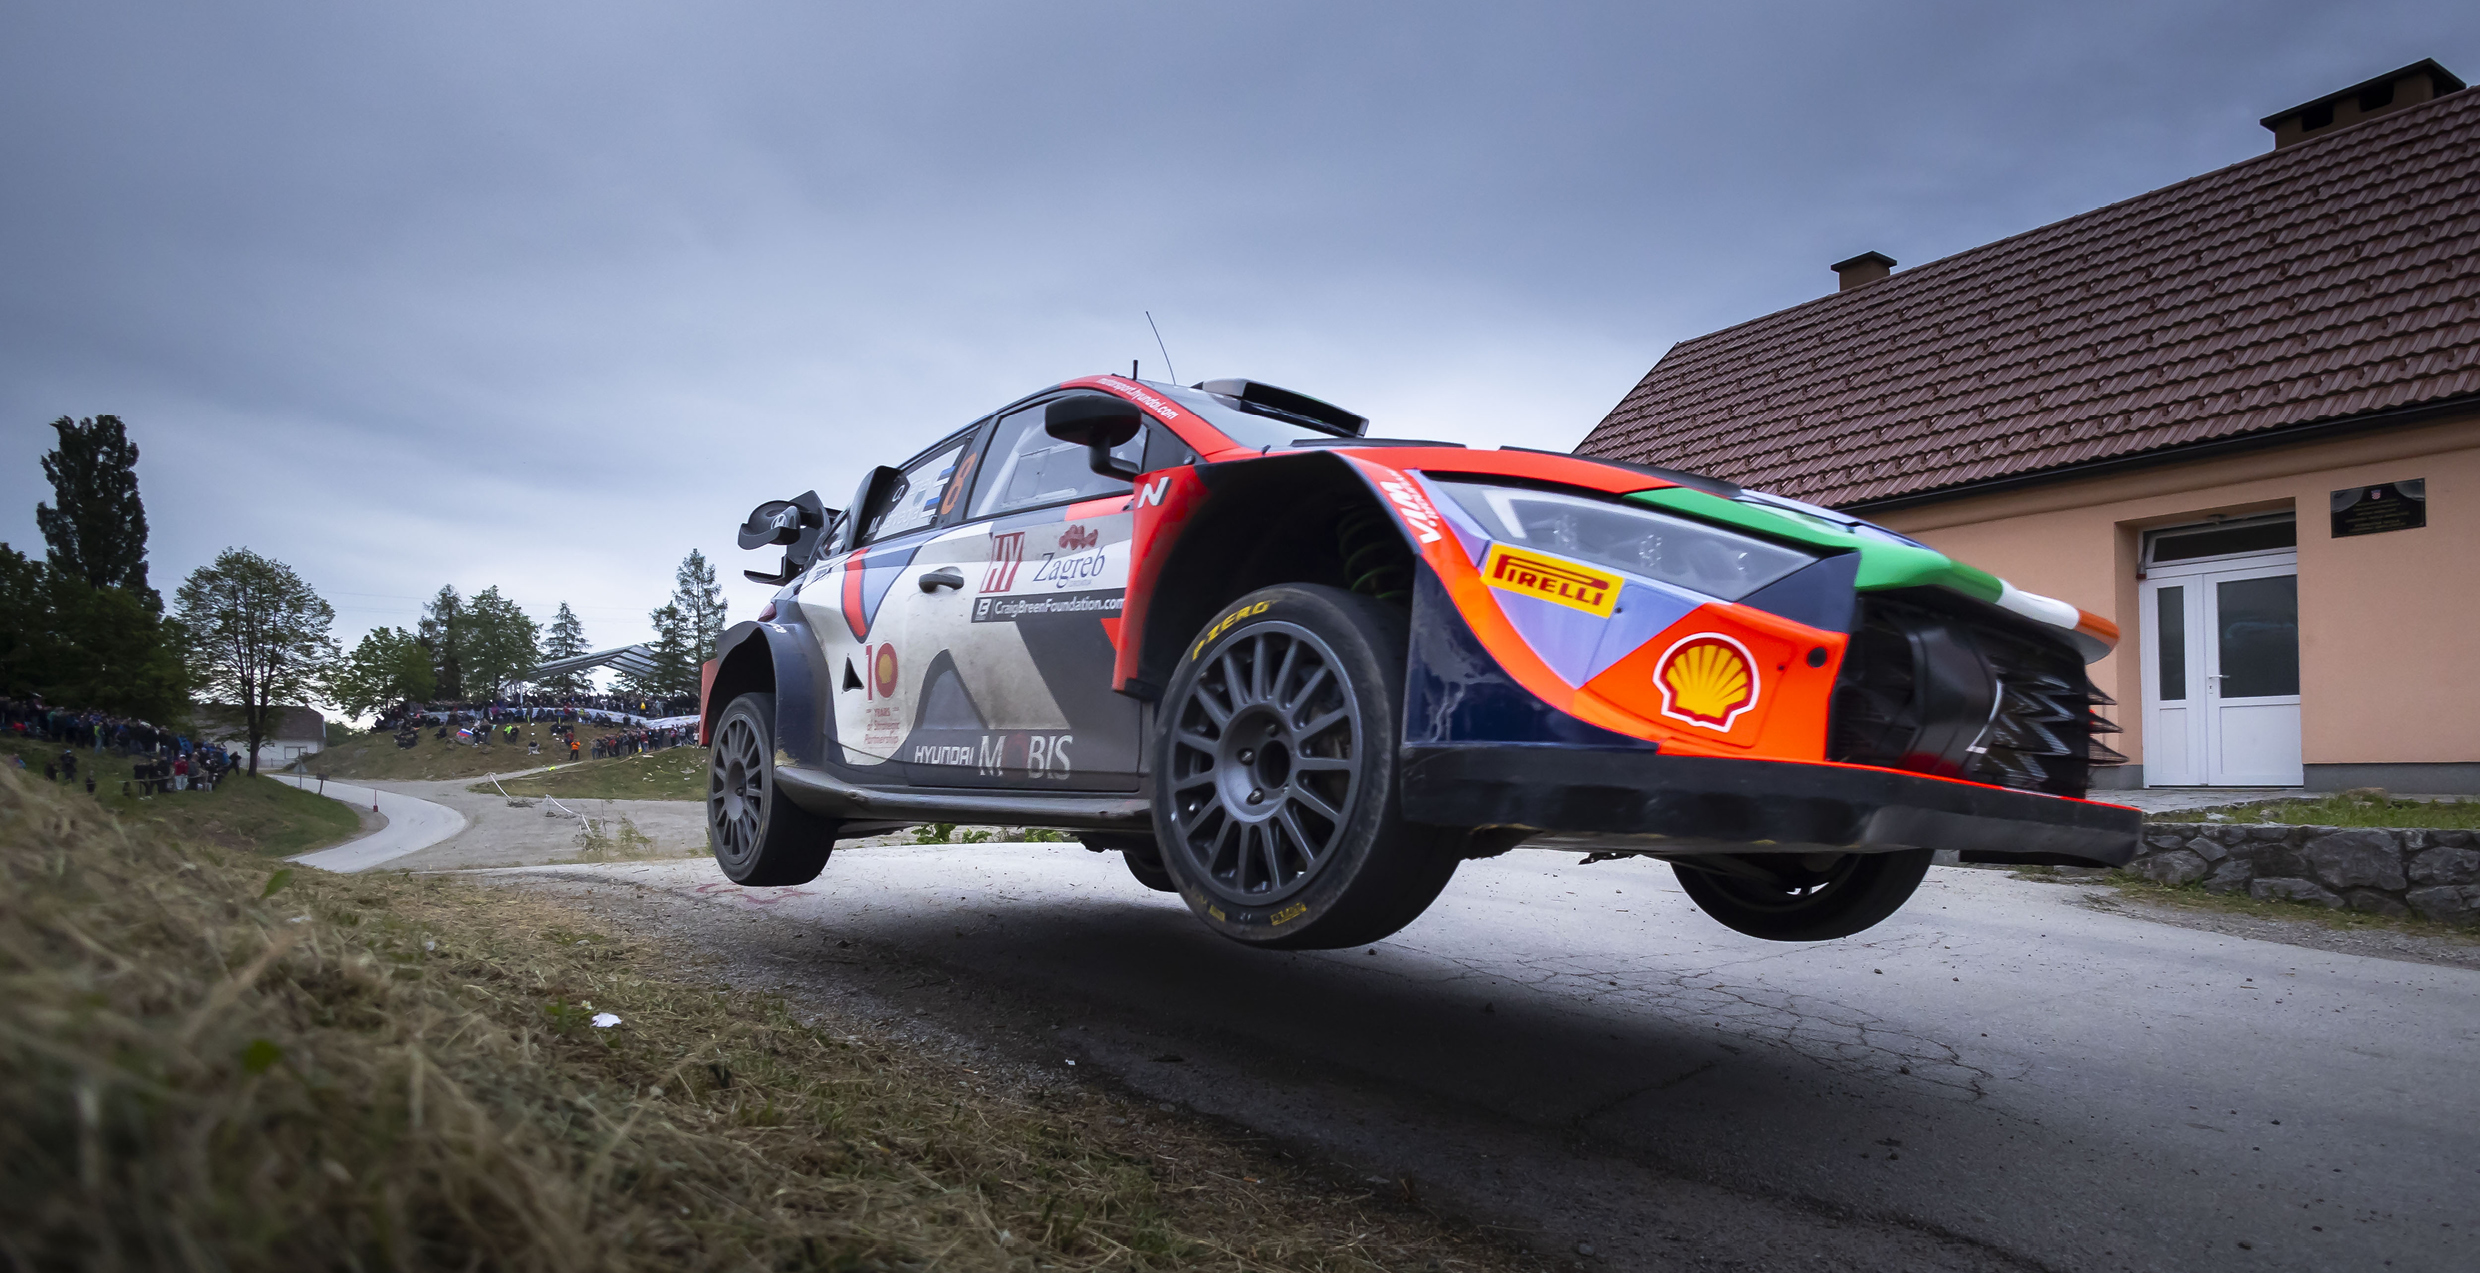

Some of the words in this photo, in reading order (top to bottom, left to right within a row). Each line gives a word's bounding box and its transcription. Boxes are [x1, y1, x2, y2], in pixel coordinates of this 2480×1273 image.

[941, 453, 977, 515] 8
[1138, 476, 1171, 509] N
[1033, 546, 1105, 589] Zagreb
[1493, 553, 1610, 607] PIRELLI
[995, 596, 1125, 618] CraigBreenFoundation.com
[1206, 600, 1270, 645] ZERO
[866, 642, 898, 701] 10
[914, 745, 974, 766] HYUNDAI
